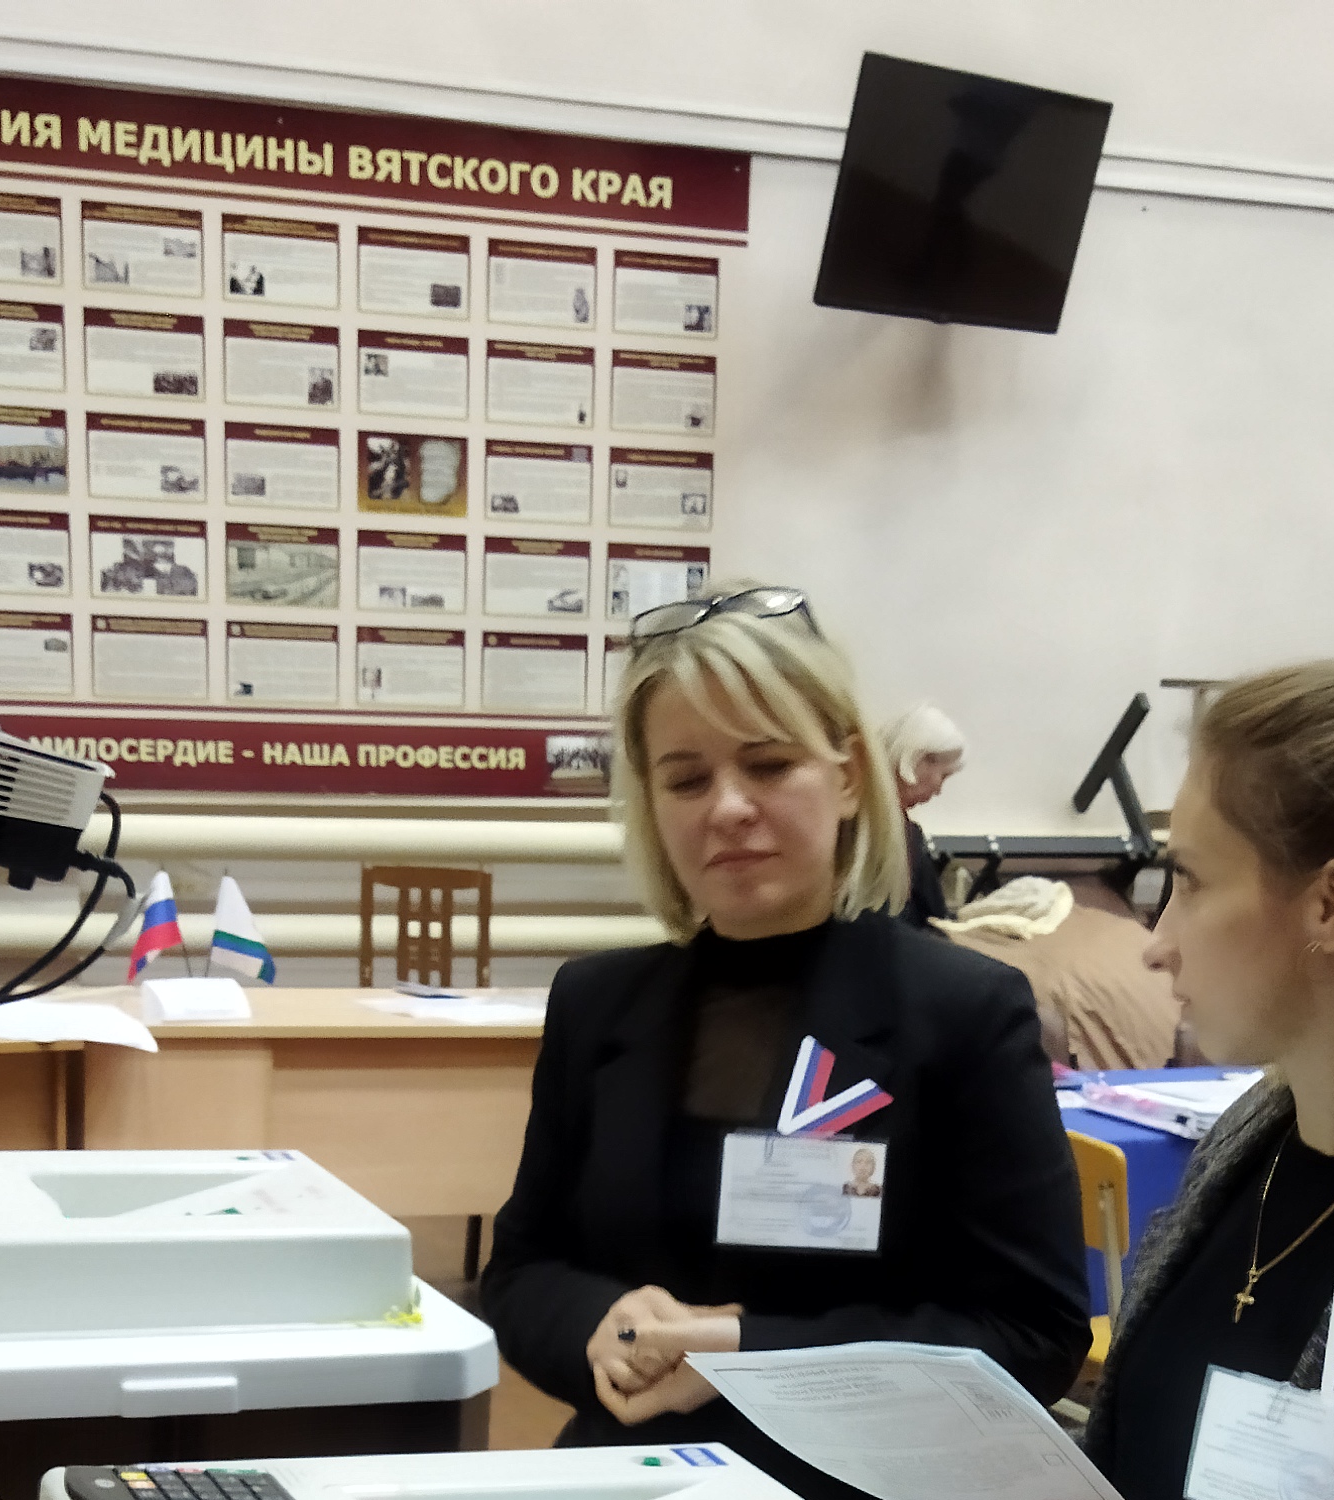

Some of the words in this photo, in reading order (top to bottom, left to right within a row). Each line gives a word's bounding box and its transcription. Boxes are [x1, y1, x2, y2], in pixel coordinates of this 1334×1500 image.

[77, 116, 335, 178] МЕДИЦИНЫ
[347, 144, 560, 200] ВЯТСКОГО
[571, 168, 674, 210] КРАЯ
[262, 741, 351, 768] НАША
[357, 743, 526, 771] ПРОФЕССИЯ
